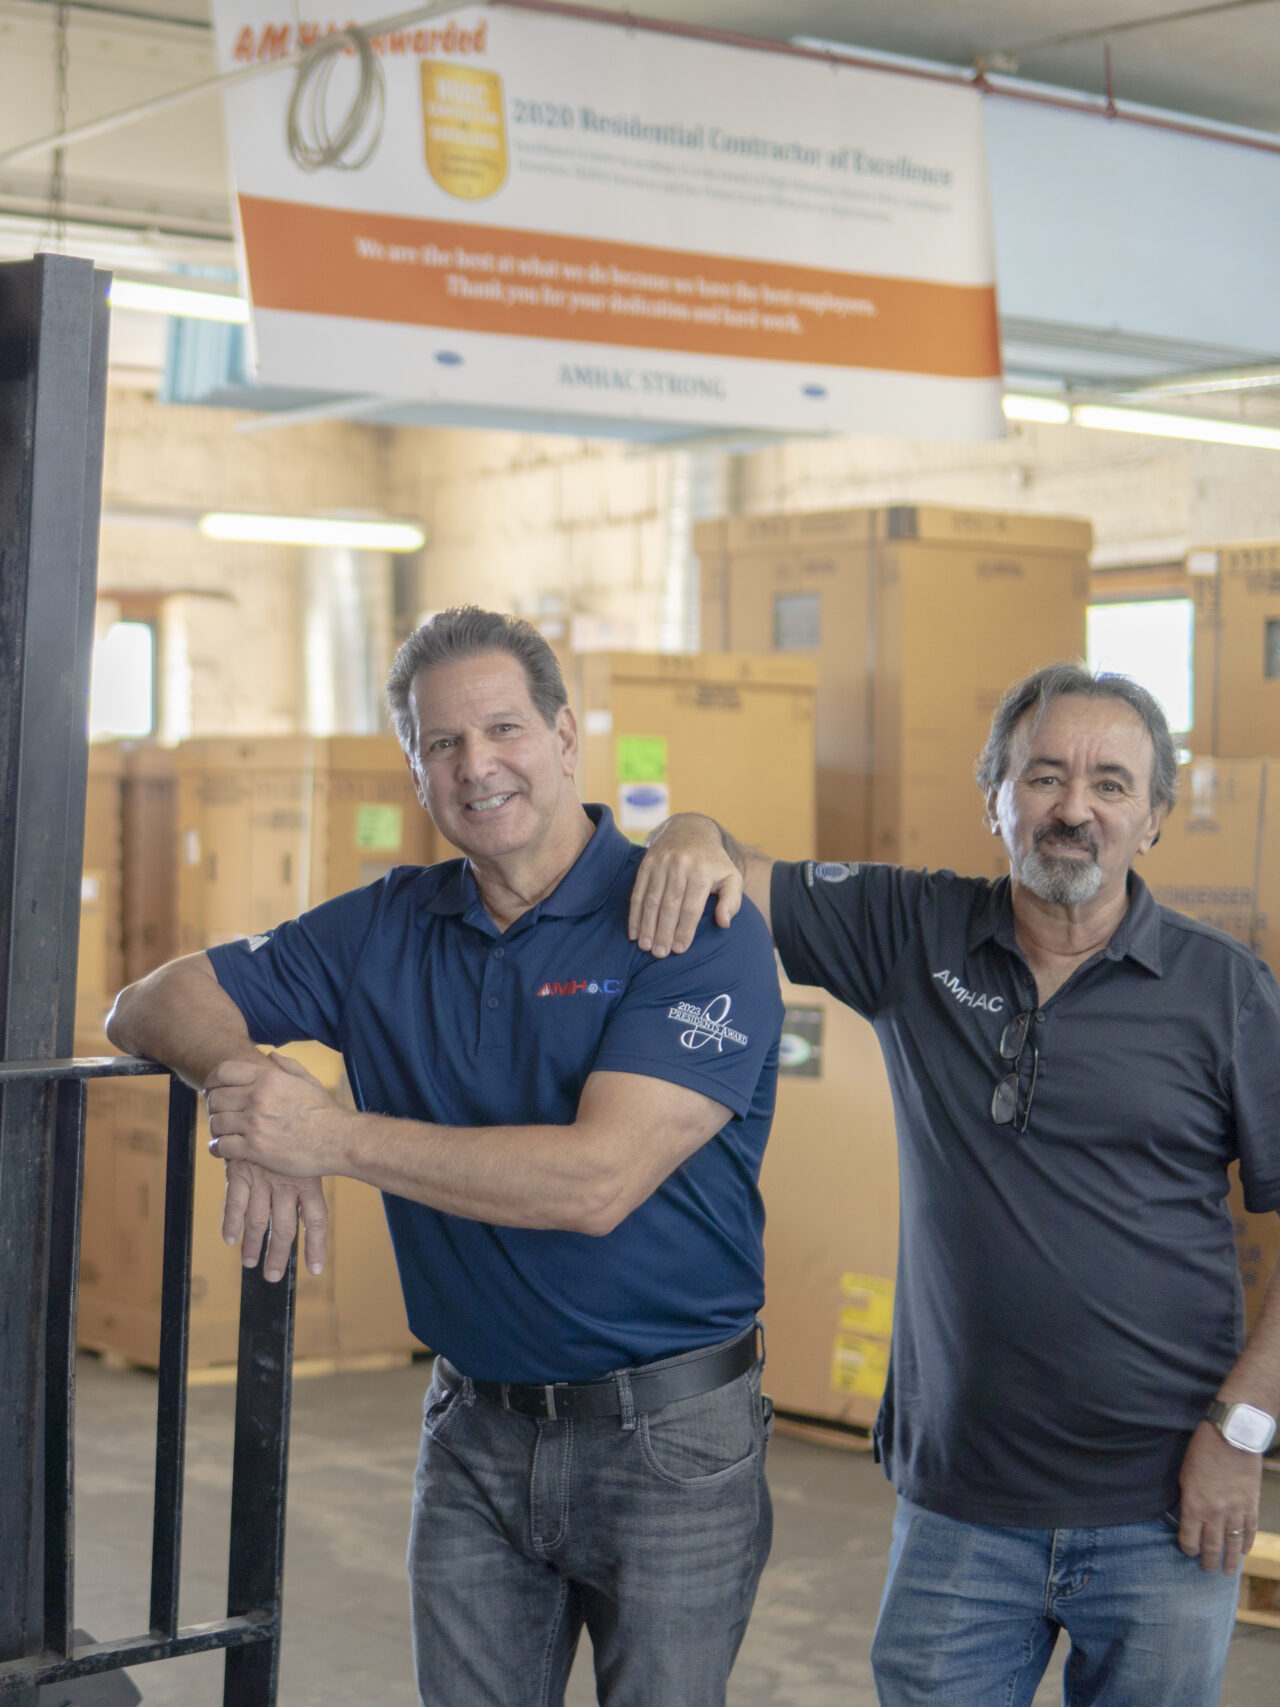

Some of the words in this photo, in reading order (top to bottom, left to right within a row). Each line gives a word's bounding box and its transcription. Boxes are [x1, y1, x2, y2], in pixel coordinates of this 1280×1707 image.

[233, 20, 358, 61] AMH
[514, 98, 575, 129] 2020
[579, 105, 704, 149] Residential
[709, 127, 820, 166] Contractor
[827, 146, 849, 172] of
[852, 148, 953, 187] Excellence
[356, 237, 385, 259] We
[388, 244, 418, 263] are
[421, 244, 450, 267] the
[455, 247, 493, 271] best
[497, 254, 515, 274] at
[518, 255, 559, 280] what
[562, 263, 585, 282] we
[588, 261, 610, 284] do
[611, 264, 669, 293] because
[674, 277, 694, 296] we
[697, 274, 731, 299] have
[735, 280, 757, 303] the
[761, 282, 793, 306] best
[445, 273, 504, 300] Thank
[507, 285, 539, 308] you
[541, 283, 565, 306] for
[567, 291, 604, 314] your
[609, 293, 689, 321] dedication
[692, 303, 720, 327] and
[722, 303, 758, 330] hard
[559, 362, 636, 391] AMHAC
[642, 367, 726, 400] STRONG
[537, 979, 620, 996] AMHAC
[933, 968, 1004, 1013] AMHAC
[668, 1007, 720, 1033] PRESIDENTS
[721, 1026, 748, 1046] AWARD
[678, 1001, 701, 1016] 2023
